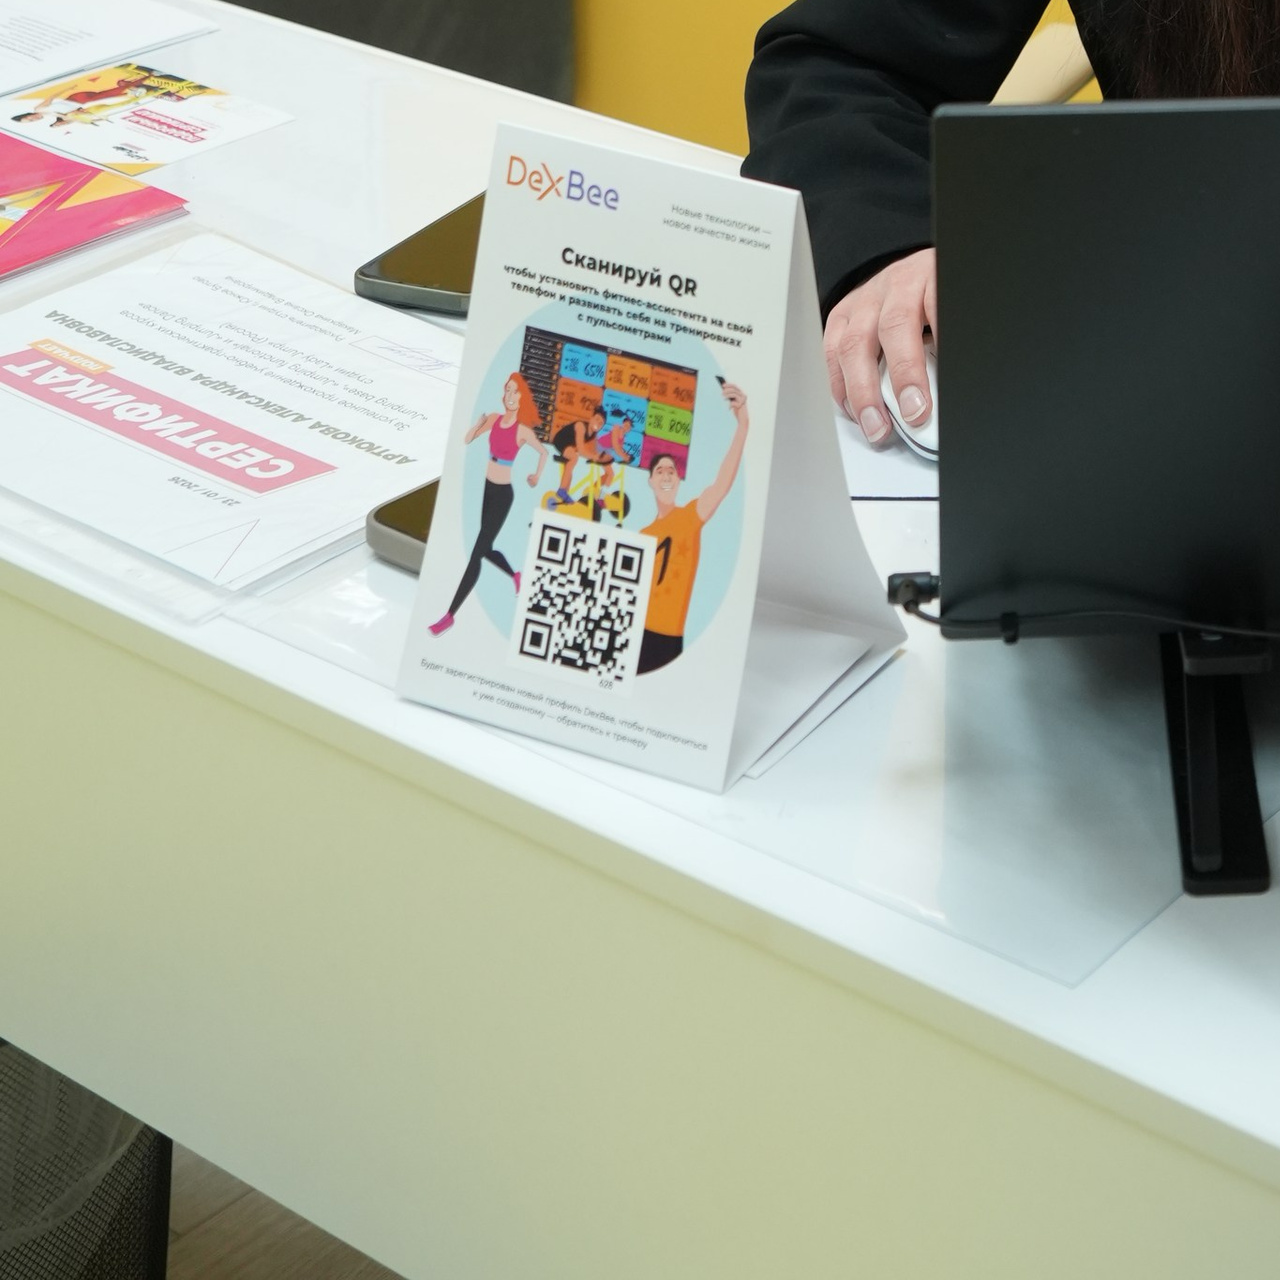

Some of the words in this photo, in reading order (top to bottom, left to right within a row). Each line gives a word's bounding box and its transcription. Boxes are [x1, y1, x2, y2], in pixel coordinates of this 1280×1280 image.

[662, 218, 692, 232] новое
[693, 225, 737, 243] качество
[738, 236, 771, 250] жизни
[671, 204, 702, 222] Новые
[705, 213, 761, 234] технологии
[561, 246, 662, 288] Сканируй
[668, 274, 698, 297] QR
[503, 264, 537, 280] чтобы
[537, 274, 600, 297] установить
[602, 288, 708, 323] фитнес-ассистента
[711, 318, 726, 328] на
[727, 320, 754, 336] свой
[511, 281, 557, 300] телефон
[568, 295, 624, 318] развивать
[626, 308, 652, 325] себя
[653, 317, 668, 328] на
[669, 321, 742, 348] тренировках
[120, 309, 158, 328] курсов
[175, 316, 223, 340] «Jumping
[218, 322, 268, 345] (Россия)
[586, 314, 672, 345] пульсометрами
[36, 342, 103, 373] ПОЛУЧАЕТ
[44, 310, 194, 376] ВЛАДИСЛАВОВНА
[158, 327, 267, 374] учебно-практических
[264, 371, 337, 403] прохождение
[287, 363, 339, 387] «Jumping
[334, 367, 374, 386] студии
[190, 373, 313, 423] АЛЕКСАНДРА
[338, 400, 397, 427] успешное
[375, 397, 428, 421] «Jumping
[2, 359, 295, 479] СЕРТИФИКАТ
[395, 421, 410, 432] За
[307, 421, 418, 465] АРТЮКОВА
[421, 658, 444, 672] Будет
[445, 666, 515, 693] зарегистрирован
[517, 687, 543, 701] новый
[545, 696, 582, 714] профиль
[618, 718, 644, 733] чтобы
[599, 680, 613, 690] 628
[479, 692, 494, 703] уже
[495, 698, 546, 719] созданному
[556, 715, 604, 736] обратитесь
